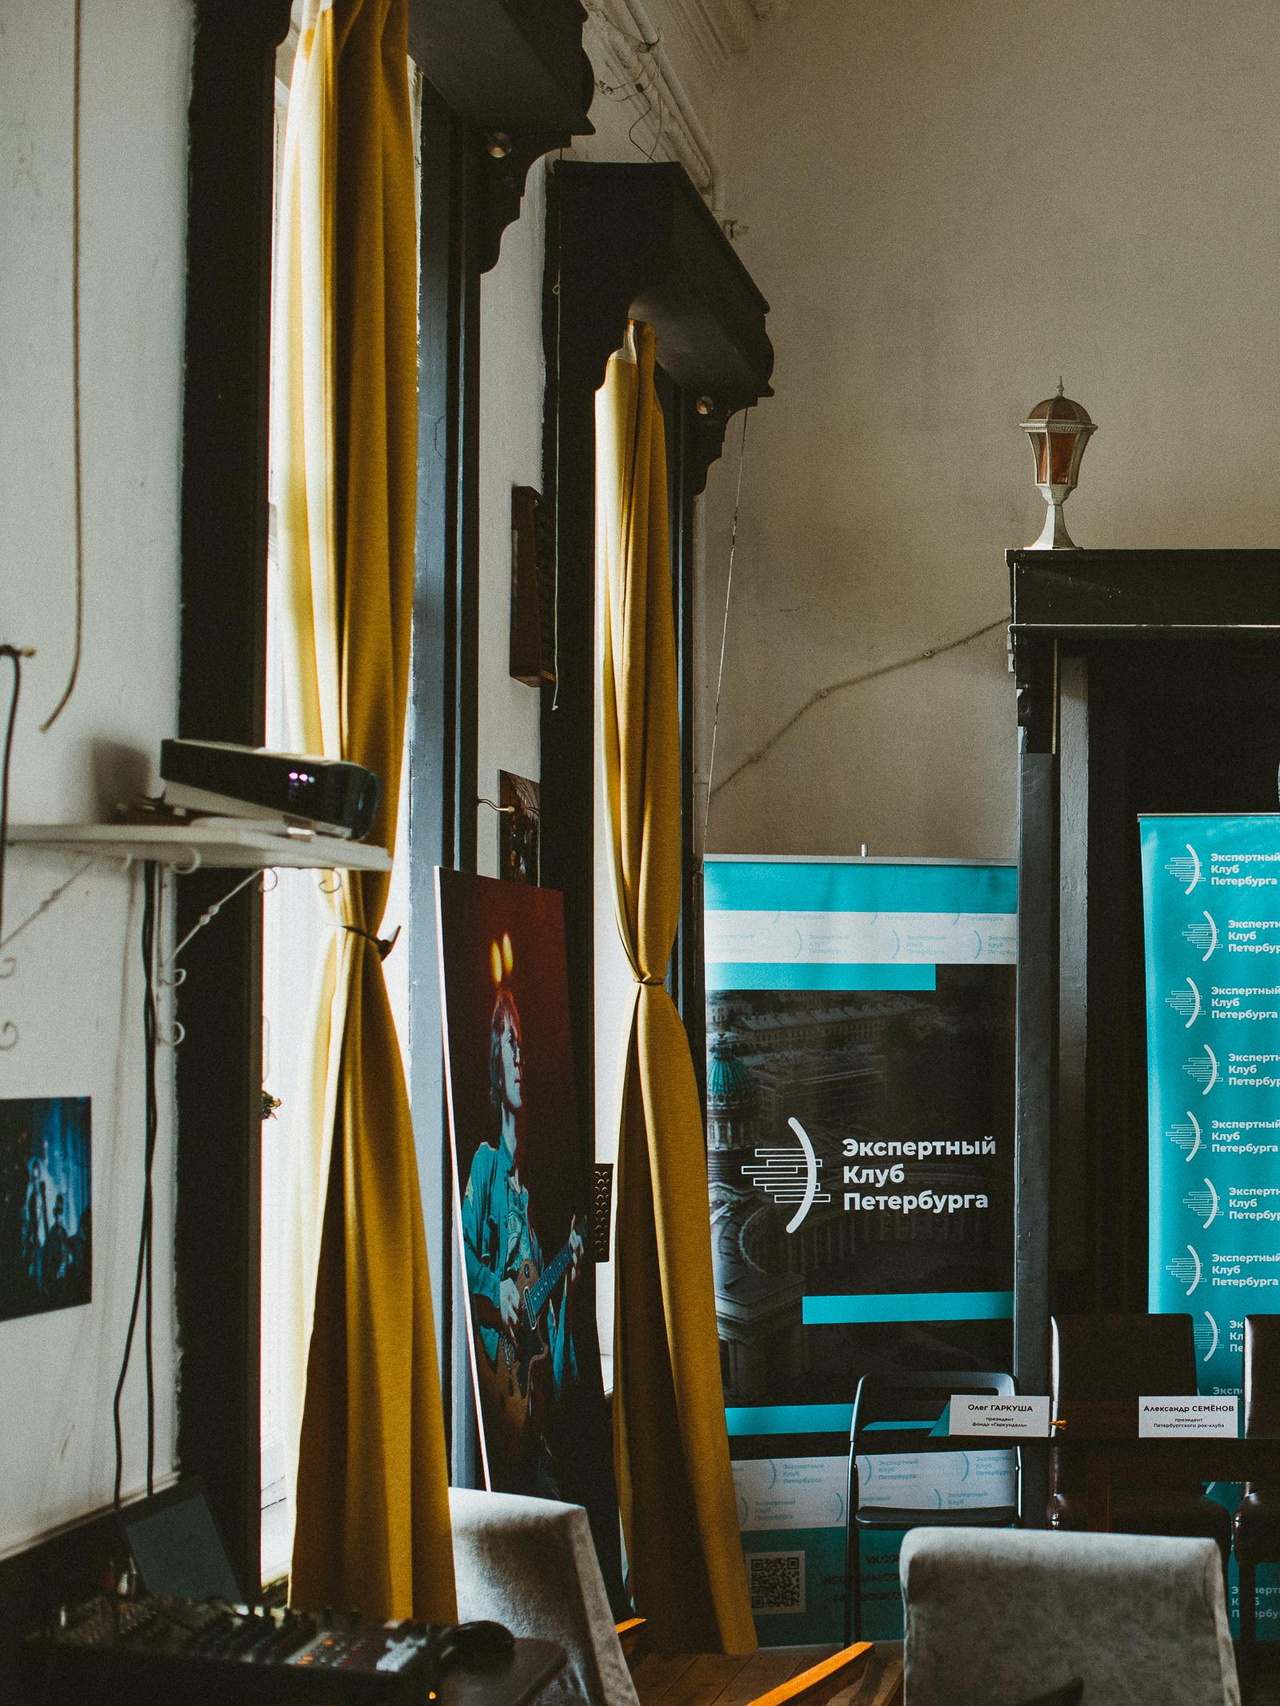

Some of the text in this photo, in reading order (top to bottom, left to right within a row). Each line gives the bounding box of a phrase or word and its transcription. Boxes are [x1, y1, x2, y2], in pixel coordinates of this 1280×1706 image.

[1211, 851, 1280, 864] Экспертный
[1211, 863, 1239, 875] Клуб
[1211, 875, 1277, 887] Петербурга
[1229, 930, 1256, 942] Клуб
[1212, 984, 1280, 997] Экспертный
[1212, 997, 1239, 1009] Клуб
[1212, 1008, 1278, 1021] Петербурга
[1229, 1063, 1257, 1075] Клуб
[1212, 1130, 1240, 1142] Клуб
[842, 1136, 996, 1160] Экспертный
[1212, 1142, 1278, 1154] Петербурга
[843, 1164, 905, 1187] Клуб
[843, 1190, 988, 1213] Петербурга
[1229, 1197, 1257, 1209] Клуб
[1212, 1263, 1240, 1275] Клуб
[1213, 1275, 1278, 1287] Петербурга
[968, 1404, 1033, 1413] Олег ГАРКУША
[1144, 1402, 1235, 1413] Александр СЕМЁНОВ
